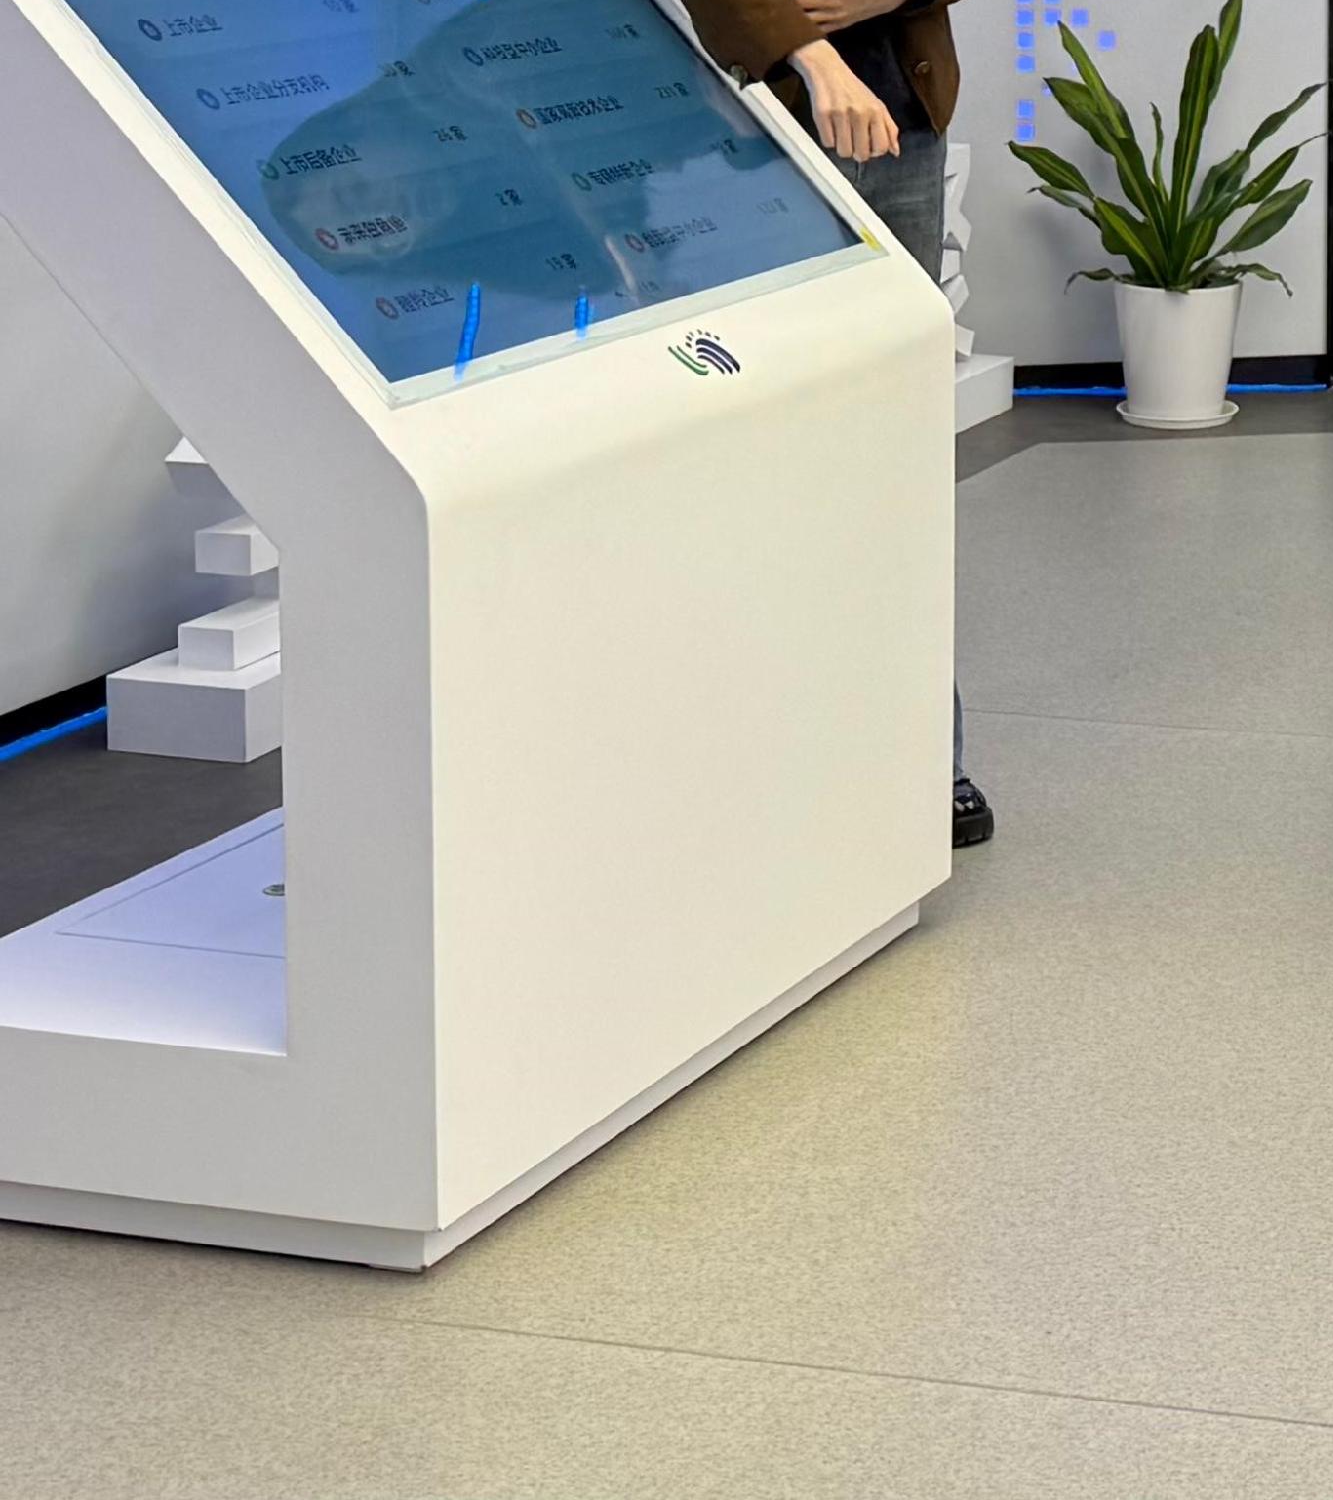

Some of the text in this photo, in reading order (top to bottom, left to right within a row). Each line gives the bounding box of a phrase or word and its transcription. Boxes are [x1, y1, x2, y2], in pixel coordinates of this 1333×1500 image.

[164, 14, 224, 37] 上市企业
[220, 73, 330, 105] 上市企业分支机构
[280, 144, 362, 175] 上市后备企业
